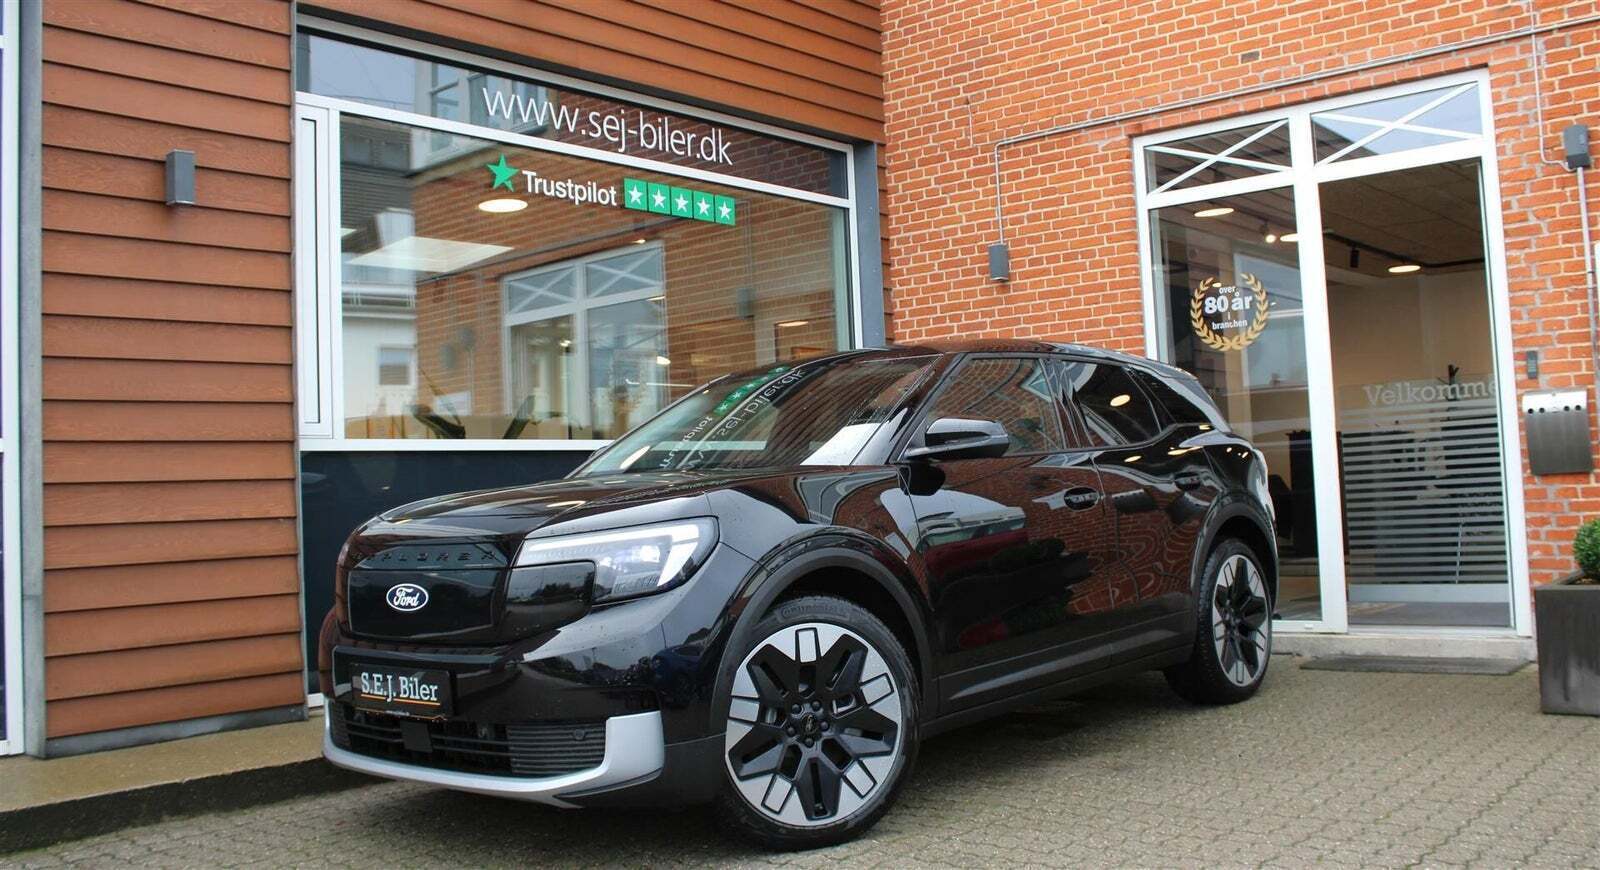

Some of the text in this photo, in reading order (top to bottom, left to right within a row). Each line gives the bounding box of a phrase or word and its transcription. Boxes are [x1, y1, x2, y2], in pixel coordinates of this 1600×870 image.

[482, 87, 734, 166] www.sej-biler.dk
[521, 169, 617, 206] Trustpilot
[1204, 288, 1253, 314] 80 år
[1219, 286, 1236, 294] over
[1211, 319, 1248, 330] branchen
[393, 586, 420, 606] Ford
[360, 671, 439, 702] S.E.J. Biler
